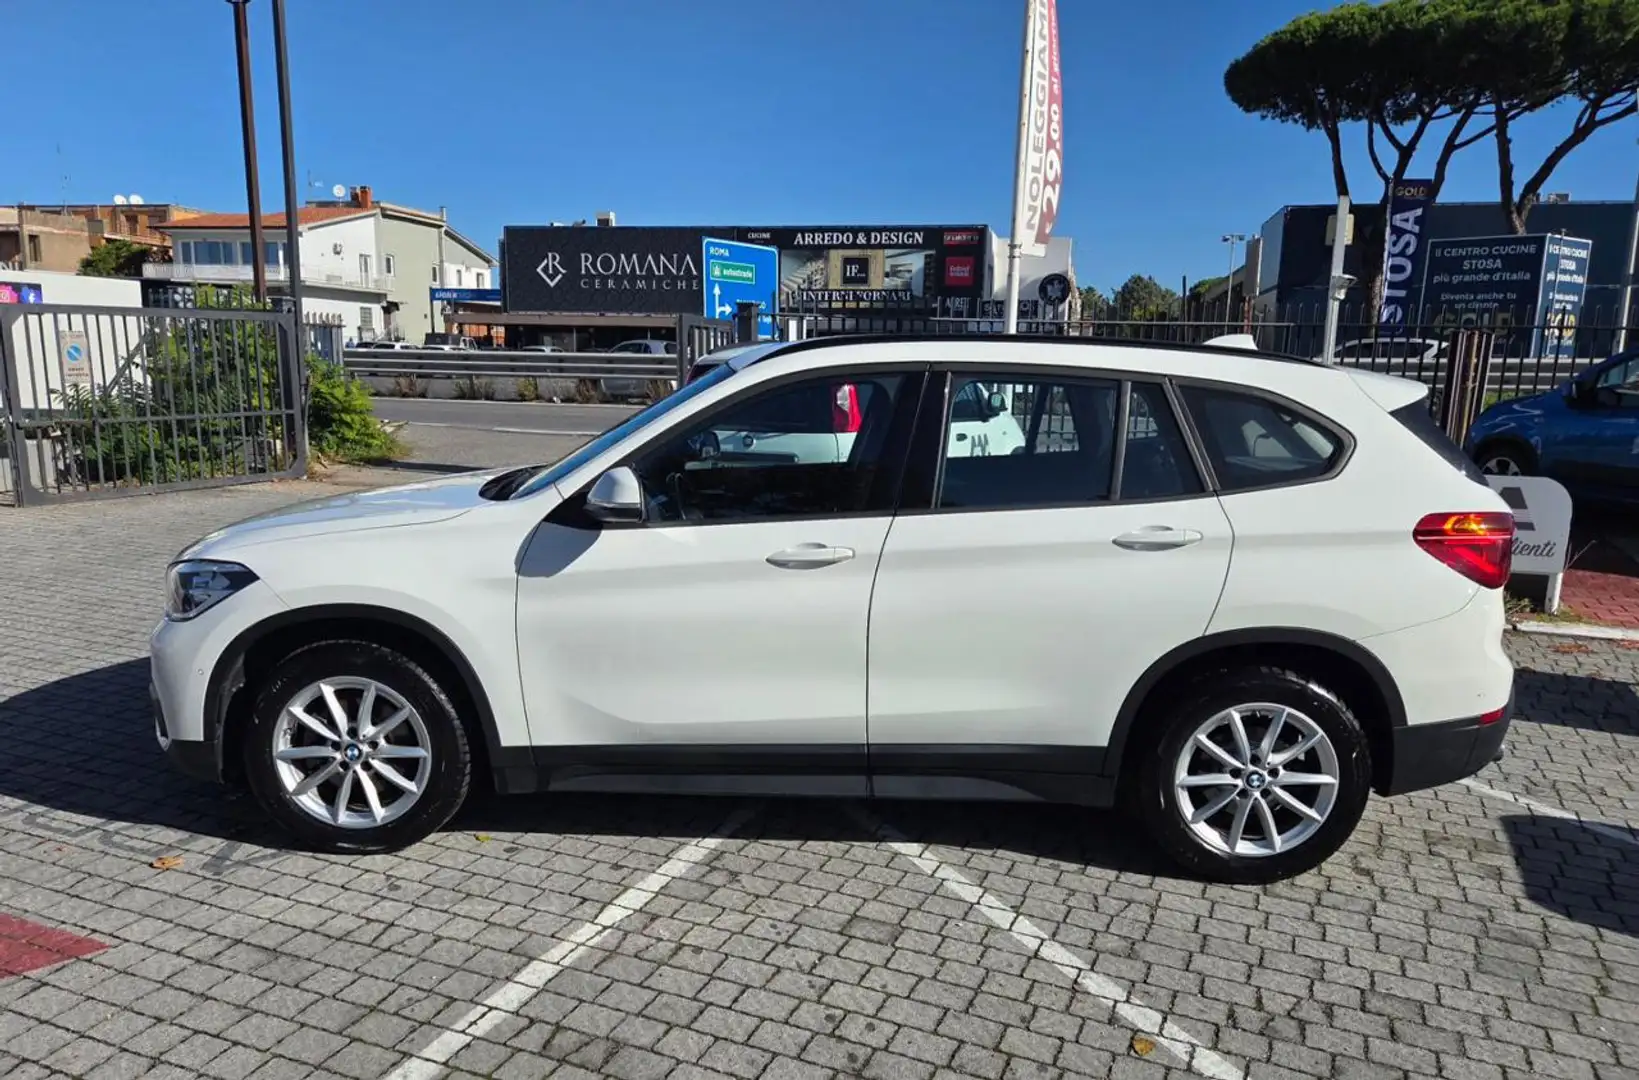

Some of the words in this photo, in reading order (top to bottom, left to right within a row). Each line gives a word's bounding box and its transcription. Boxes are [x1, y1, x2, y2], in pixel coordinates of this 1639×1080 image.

[794, 232, 853, 245] ARREDO
[856, 232, 867, 244] &
[870, 231, 924, 245] DESIGN
[710, 247, 729, 257] ROMA
[1444, 246, 1489, 257] CENTRO
[1492, 244, 1537, 255] CUCINE
[580, 253, 698, 275] ROMANA
[1379, 207, 1423, 326] STOSA
[1463, 259, 1503, 270] STOSA
[580, 278, 699, 290] CERAMICHE
[1452, 272, 1491, 284] grande
[1511, 537, 1556, 558] lienti
